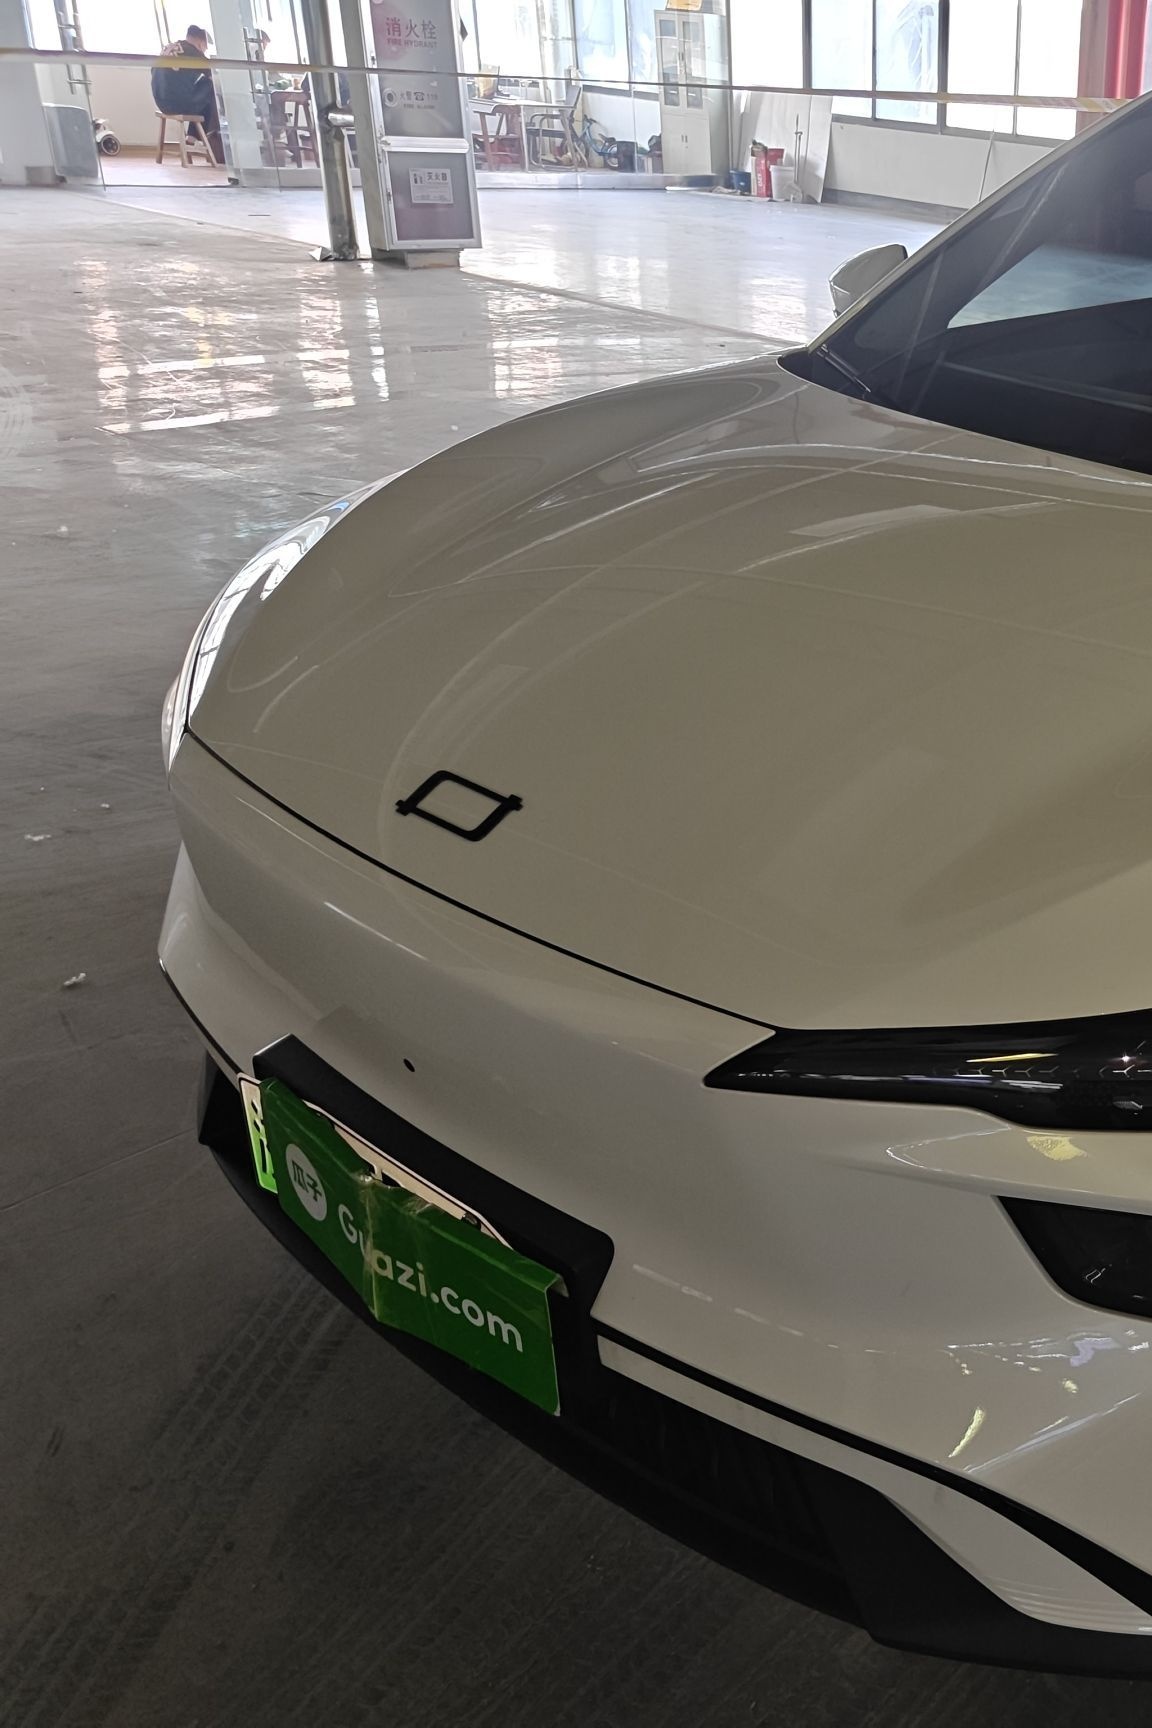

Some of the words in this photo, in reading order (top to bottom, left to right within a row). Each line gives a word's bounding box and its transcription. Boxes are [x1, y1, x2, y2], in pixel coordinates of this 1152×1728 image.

[386, 17, 437, 40] 消火栓
[386, 38, 402, 47] FIRE
[404, 40, 438, 49] HYDRANT
[291, 1159, 323, 1202] 瓜子
